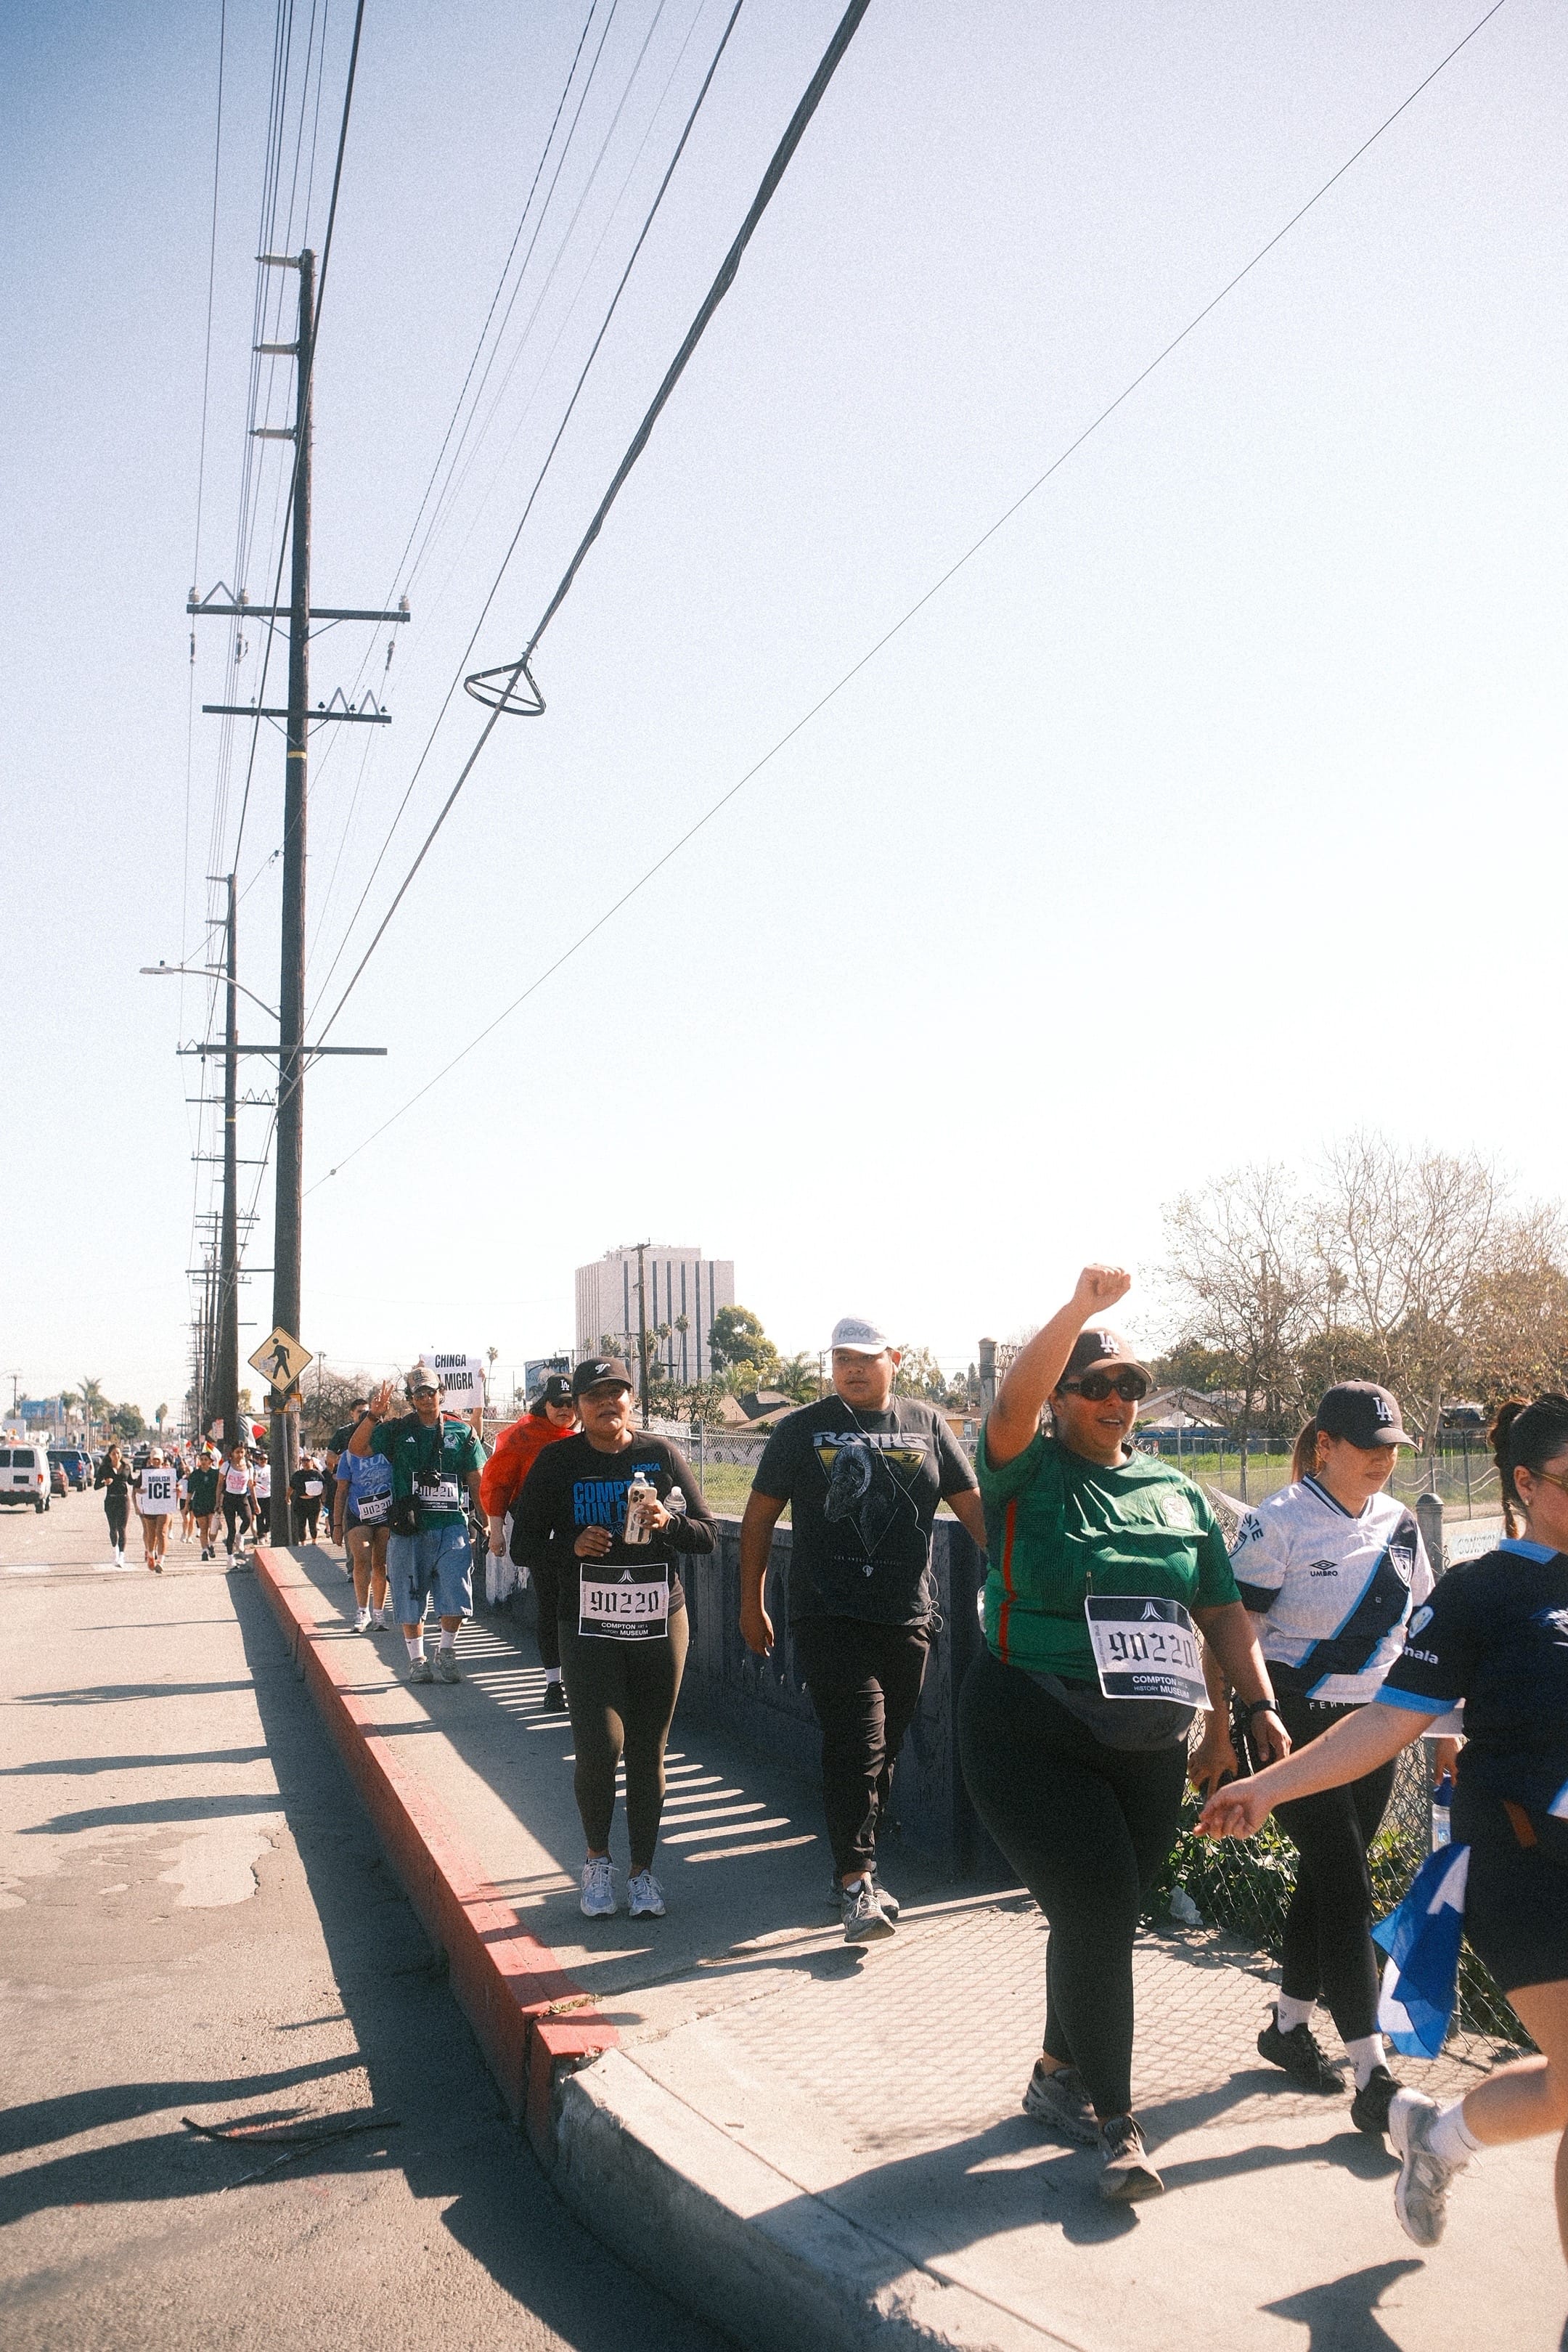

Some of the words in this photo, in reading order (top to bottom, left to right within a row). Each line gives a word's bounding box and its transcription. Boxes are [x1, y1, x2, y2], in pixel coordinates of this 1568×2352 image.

[838, 1327, 870, 1338] HOKA
[1097, 1331, 1120, 1354] LA
[435, 1354, 467, 1368] CHINGA
[444, 1371, 474, 1391] MIGRA
[560, 1379, 570, 1391] LA
[1372, 1397, 1394, 1421] LA
[632, 1463, 661, 1472] HOKA
[148, 1483, 171, 1500] ICE
[574, 1500, 612, 1525] RUN
[590, 1590, 659, 1614] 90220
[1108, 1631, 1196, 1669] 90220
[1132, 1675, 1177, 1686] COMPTON
[1160, 1685, 1190, 1699] MUSEUM
